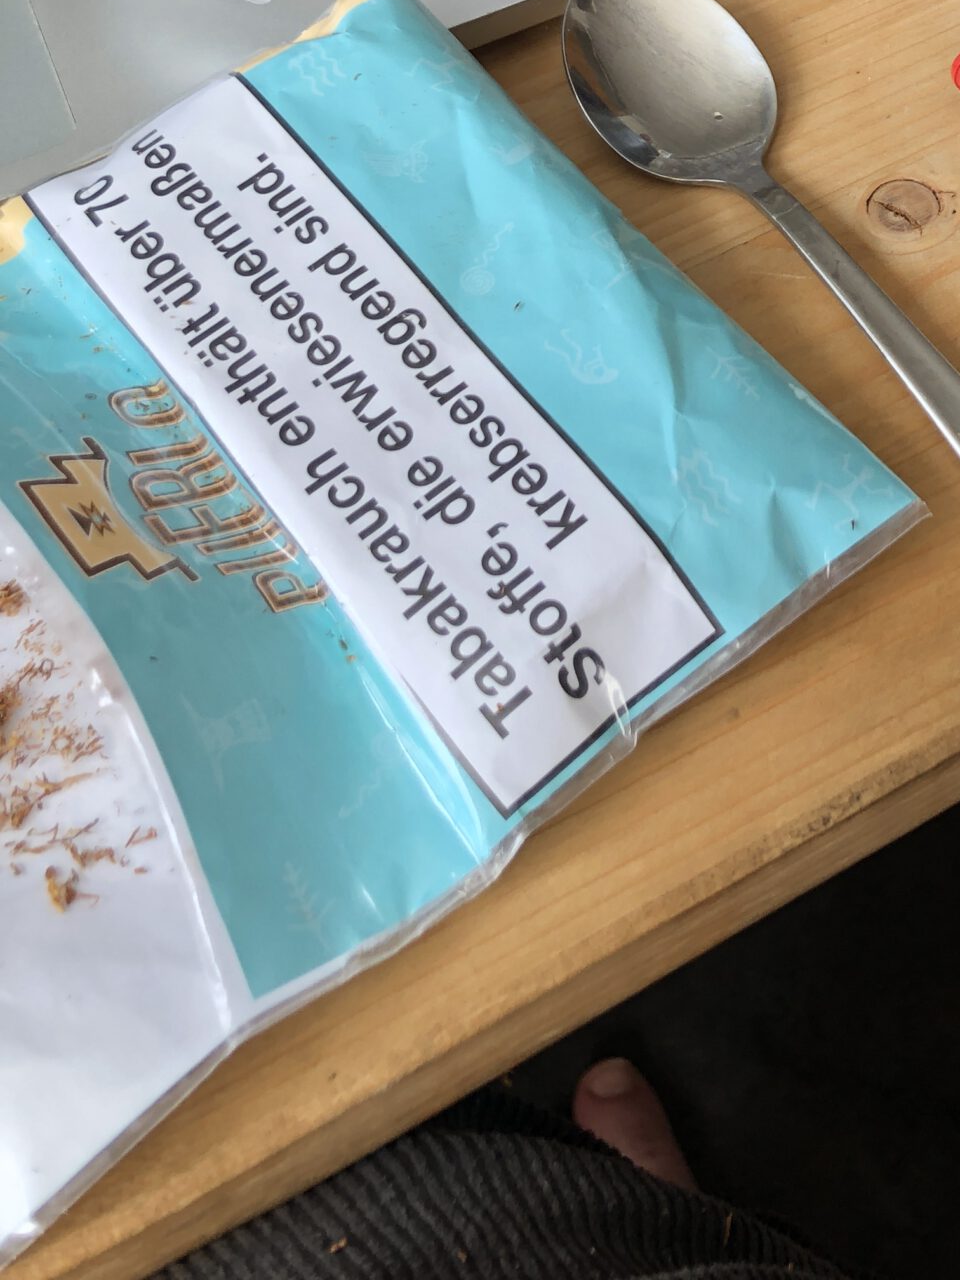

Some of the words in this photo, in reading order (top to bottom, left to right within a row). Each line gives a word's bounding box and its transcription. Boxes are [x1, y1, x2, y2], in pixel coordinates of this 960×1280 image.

[73, 175, 129, 227] 70
[114, 220, 202, 313] über
[237, 152, 330, 245] sind.
[131, 129, 414, 452] erwiesenermaßen
[181, 302, 316, 446] enthält
[307, 242, 589, 550] krebserregend
[407, 455, 476, 525] die
[303, 448, 533, 740] Tabakrauch
[481, 521, 606, 699] Stoffe,
